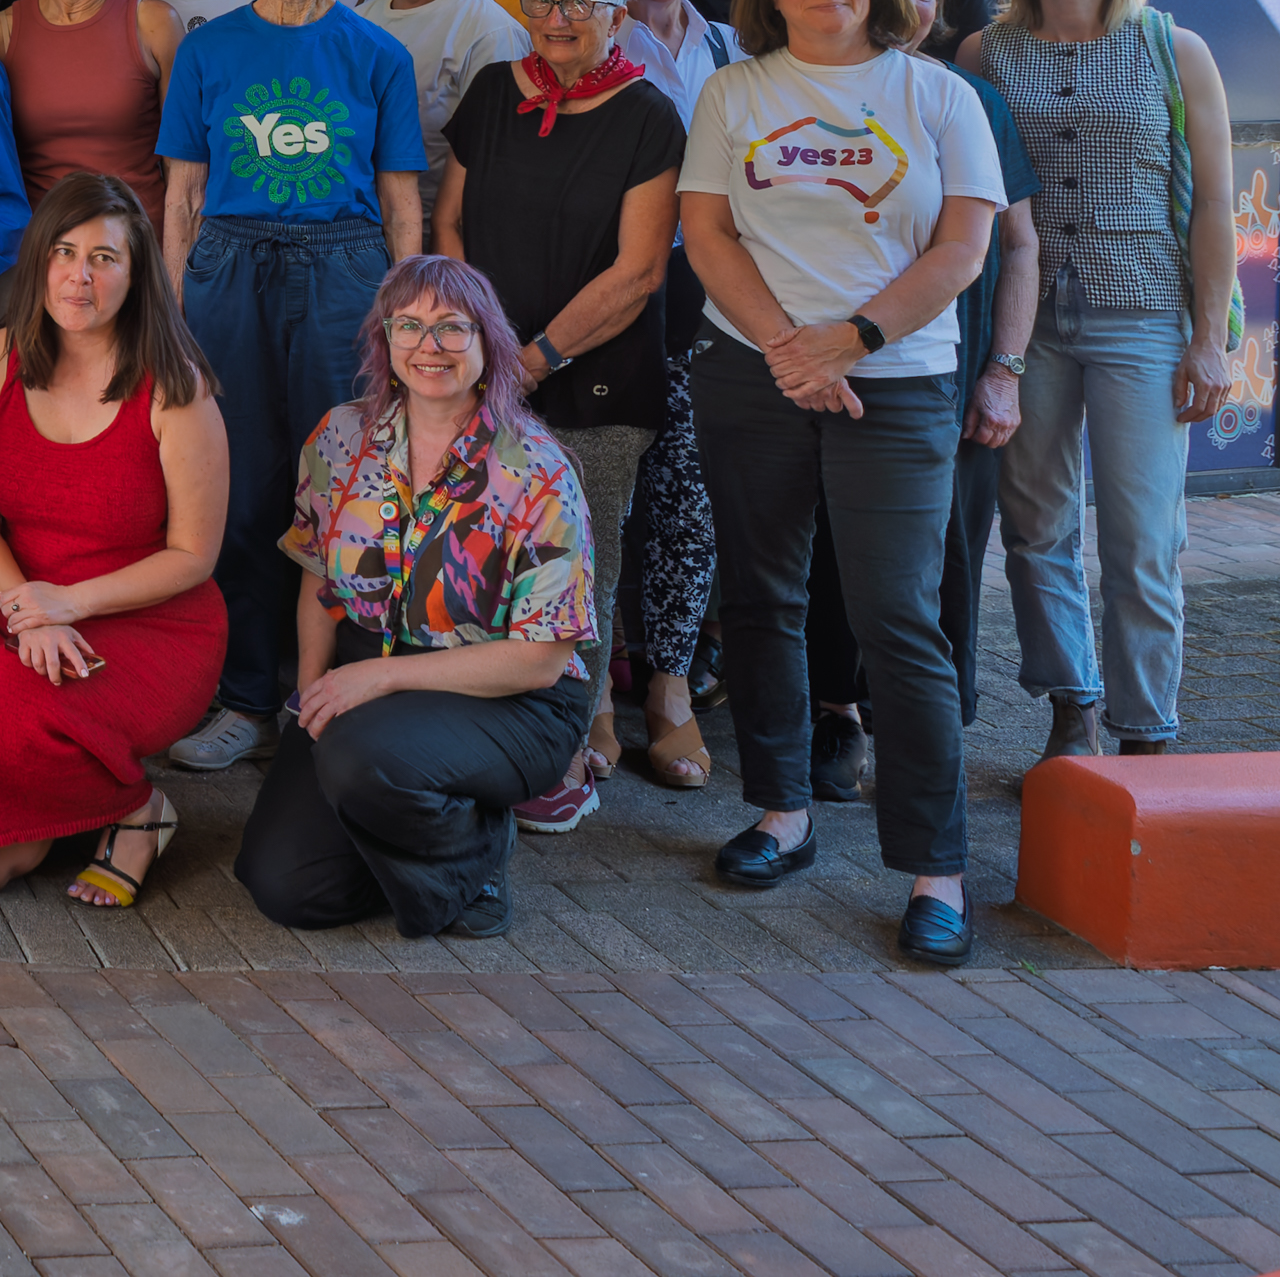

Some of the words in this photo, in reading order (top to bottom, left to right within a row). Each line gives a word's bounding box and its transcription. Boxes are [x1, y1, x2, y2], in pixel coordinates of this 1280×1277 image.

[239, 113, 330, 157] Yes
[777, 145, 873, 166] yes23
[384, 527, 399, 551] ally
[408, 531, 422, 553] ally
